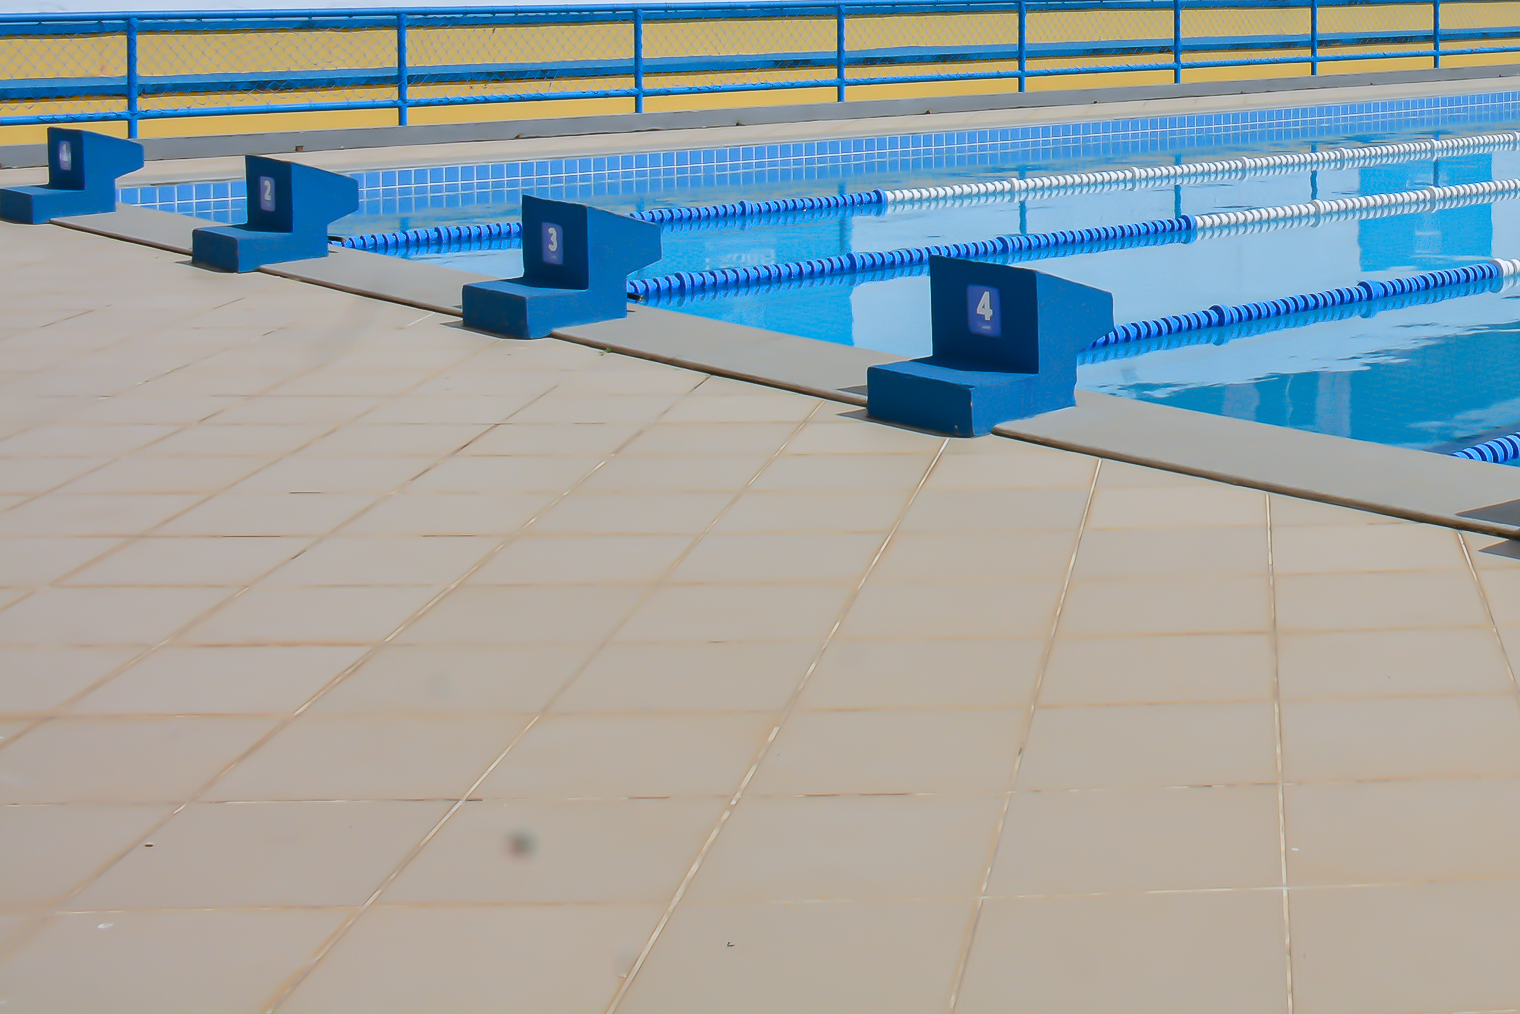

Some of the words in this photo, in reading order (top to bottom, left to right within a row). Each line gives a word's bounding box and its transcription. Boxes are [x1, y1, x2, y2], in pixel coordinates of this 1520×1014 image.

[264, 180, 272, 201] 2
[547, 227, 558, 252] 3
[976, 291, 994, 321] 4
